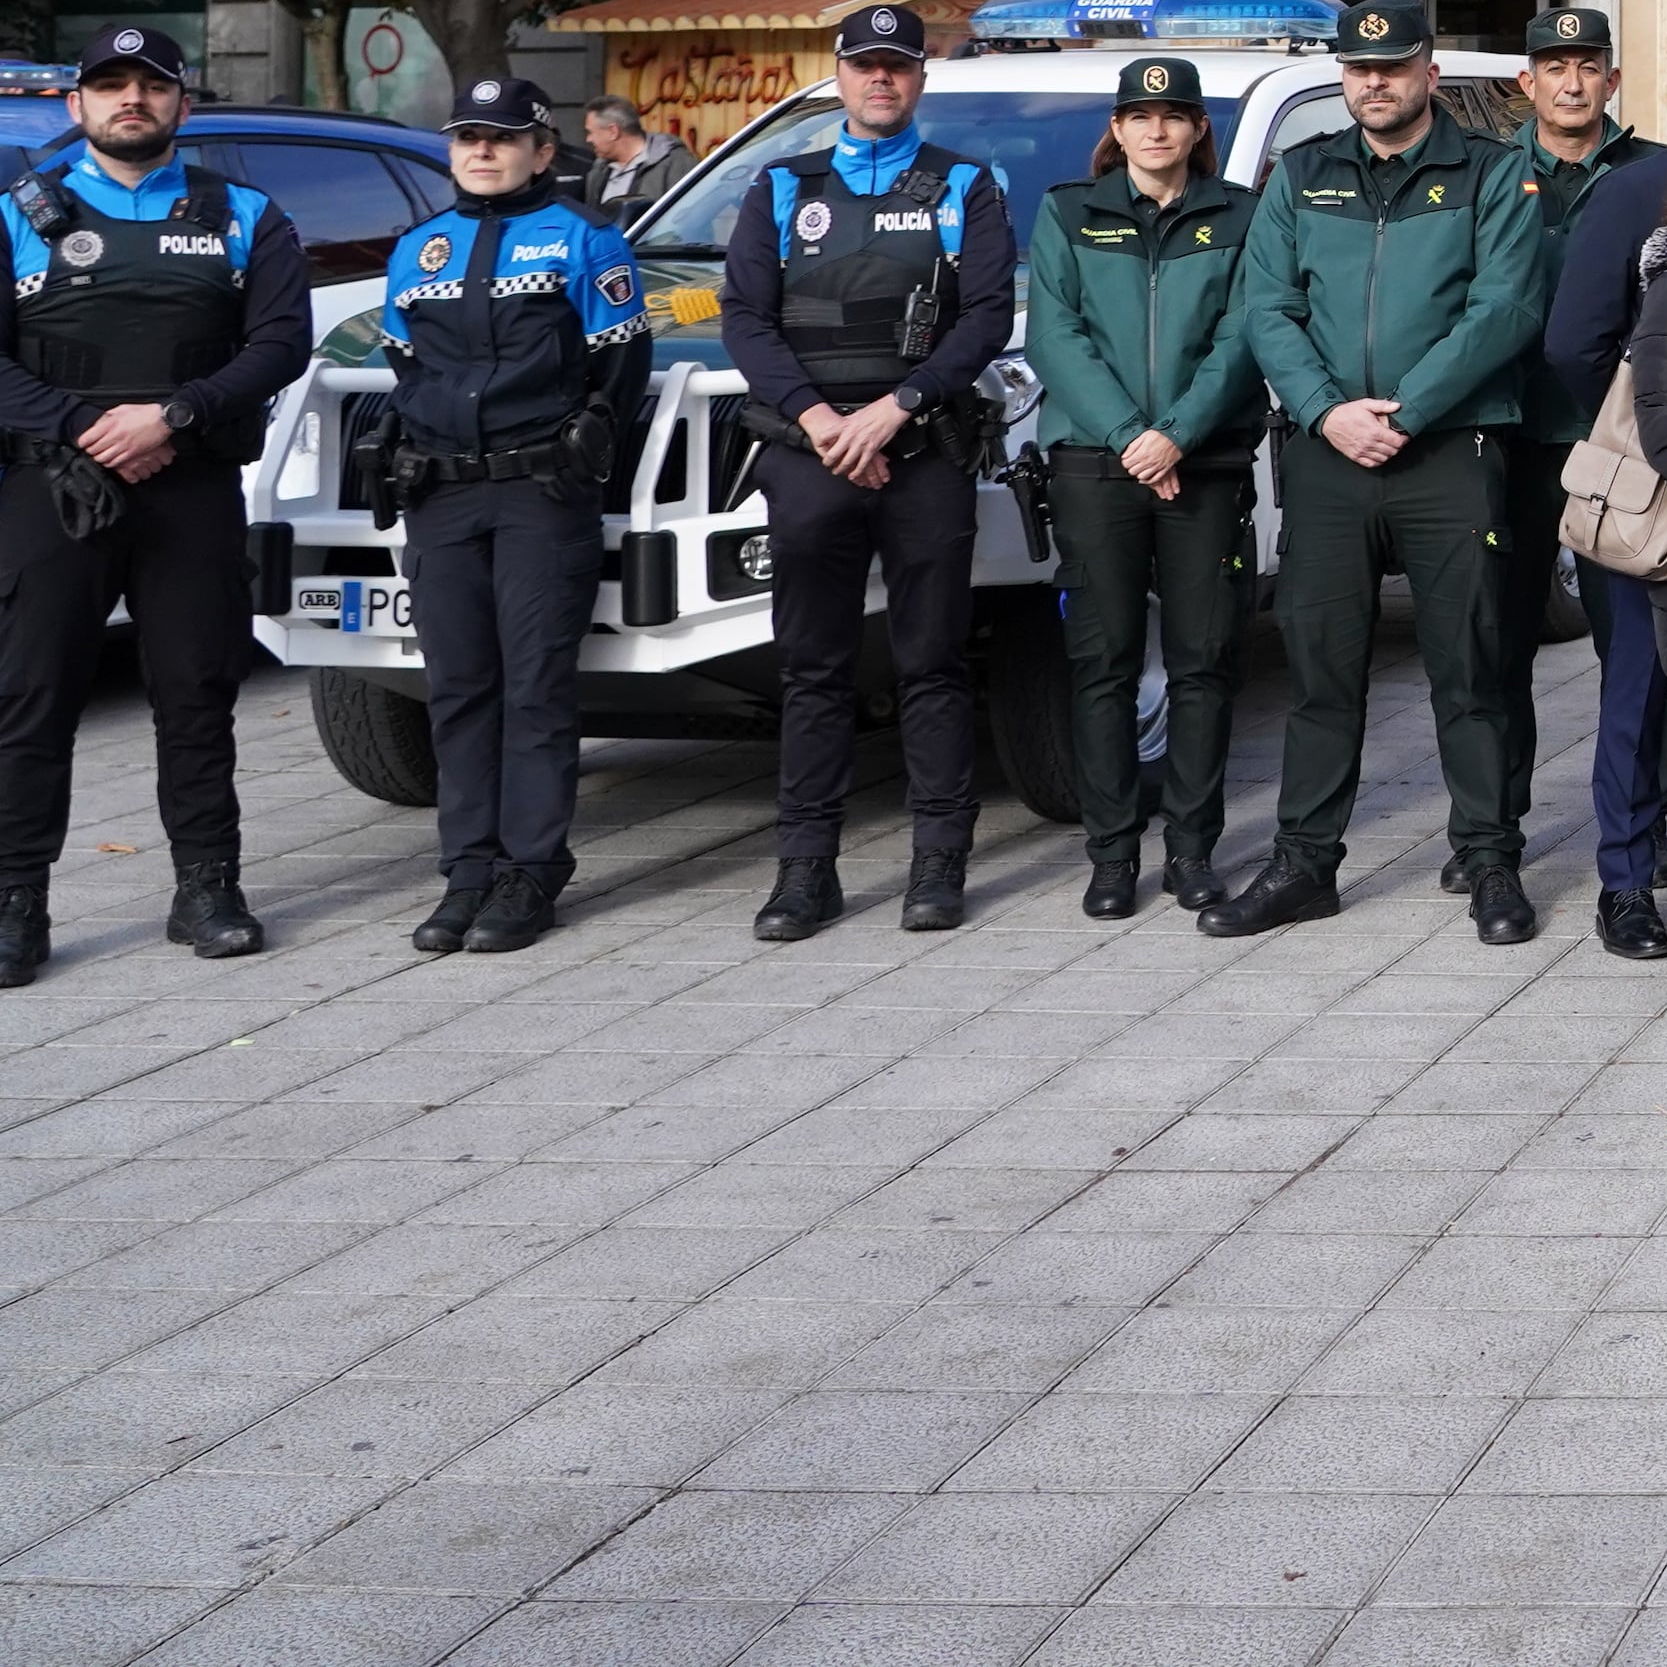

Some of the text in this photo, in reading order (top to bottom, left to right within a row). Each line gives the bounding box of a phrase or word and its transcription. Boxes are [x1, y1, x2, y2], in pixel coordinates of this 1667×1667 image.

[1087, 7, 1134, 19] CIVIL
[620, 35, 800, 115] Castañas
[1303, 189, 1358, 198] GUARDIA CIVIL
[874, 207, 932, 232] POLICÍA
[1080, 226, 1139, 236] GUARDIA CIVIL
[159, 233, 225, 256] POLICÍA
[511, 238, 569, 263] POLICÍA
[304, 594, 338, 606] ARB
